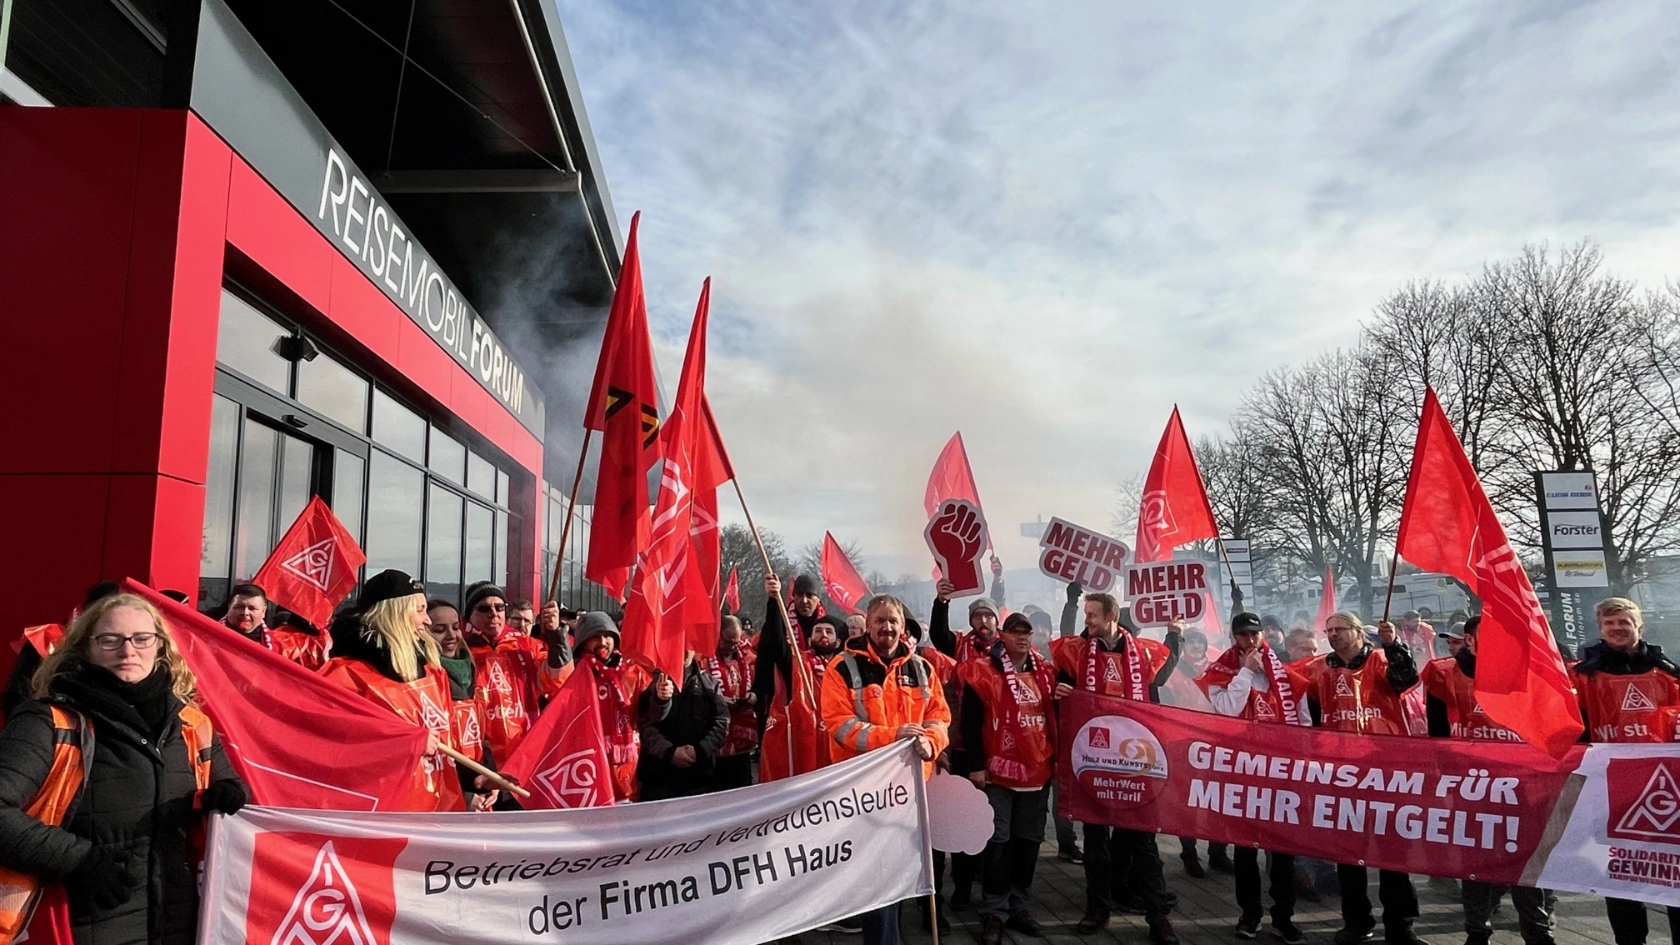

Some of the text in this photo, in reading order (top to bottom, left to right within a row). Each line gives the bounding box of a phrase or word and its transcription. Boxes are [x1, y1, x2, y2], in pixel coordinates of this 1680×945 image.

[1046, 522, 1125, 570] MEHR
[1554, 524, 1599, 535] Forster
[1044, 550, 1111, 591] GELD
[1129, 563, 1205, 596] MEHR
[1135, 593, 1202, 624] GELD
[1093, 777, 1146, 791] MehrWert
[1188, 741, 1520, 805] GEMEINSAM FÜR
[1097, 789, 1142, 802] mit Tarif
[1187, 778, 1520, 853] MEHR ENTGELT!
[424, 782, 909, 895] Betriebsrat und Vertrauensleute
[528, 839, 853, 936] der Firma DFH Haus
